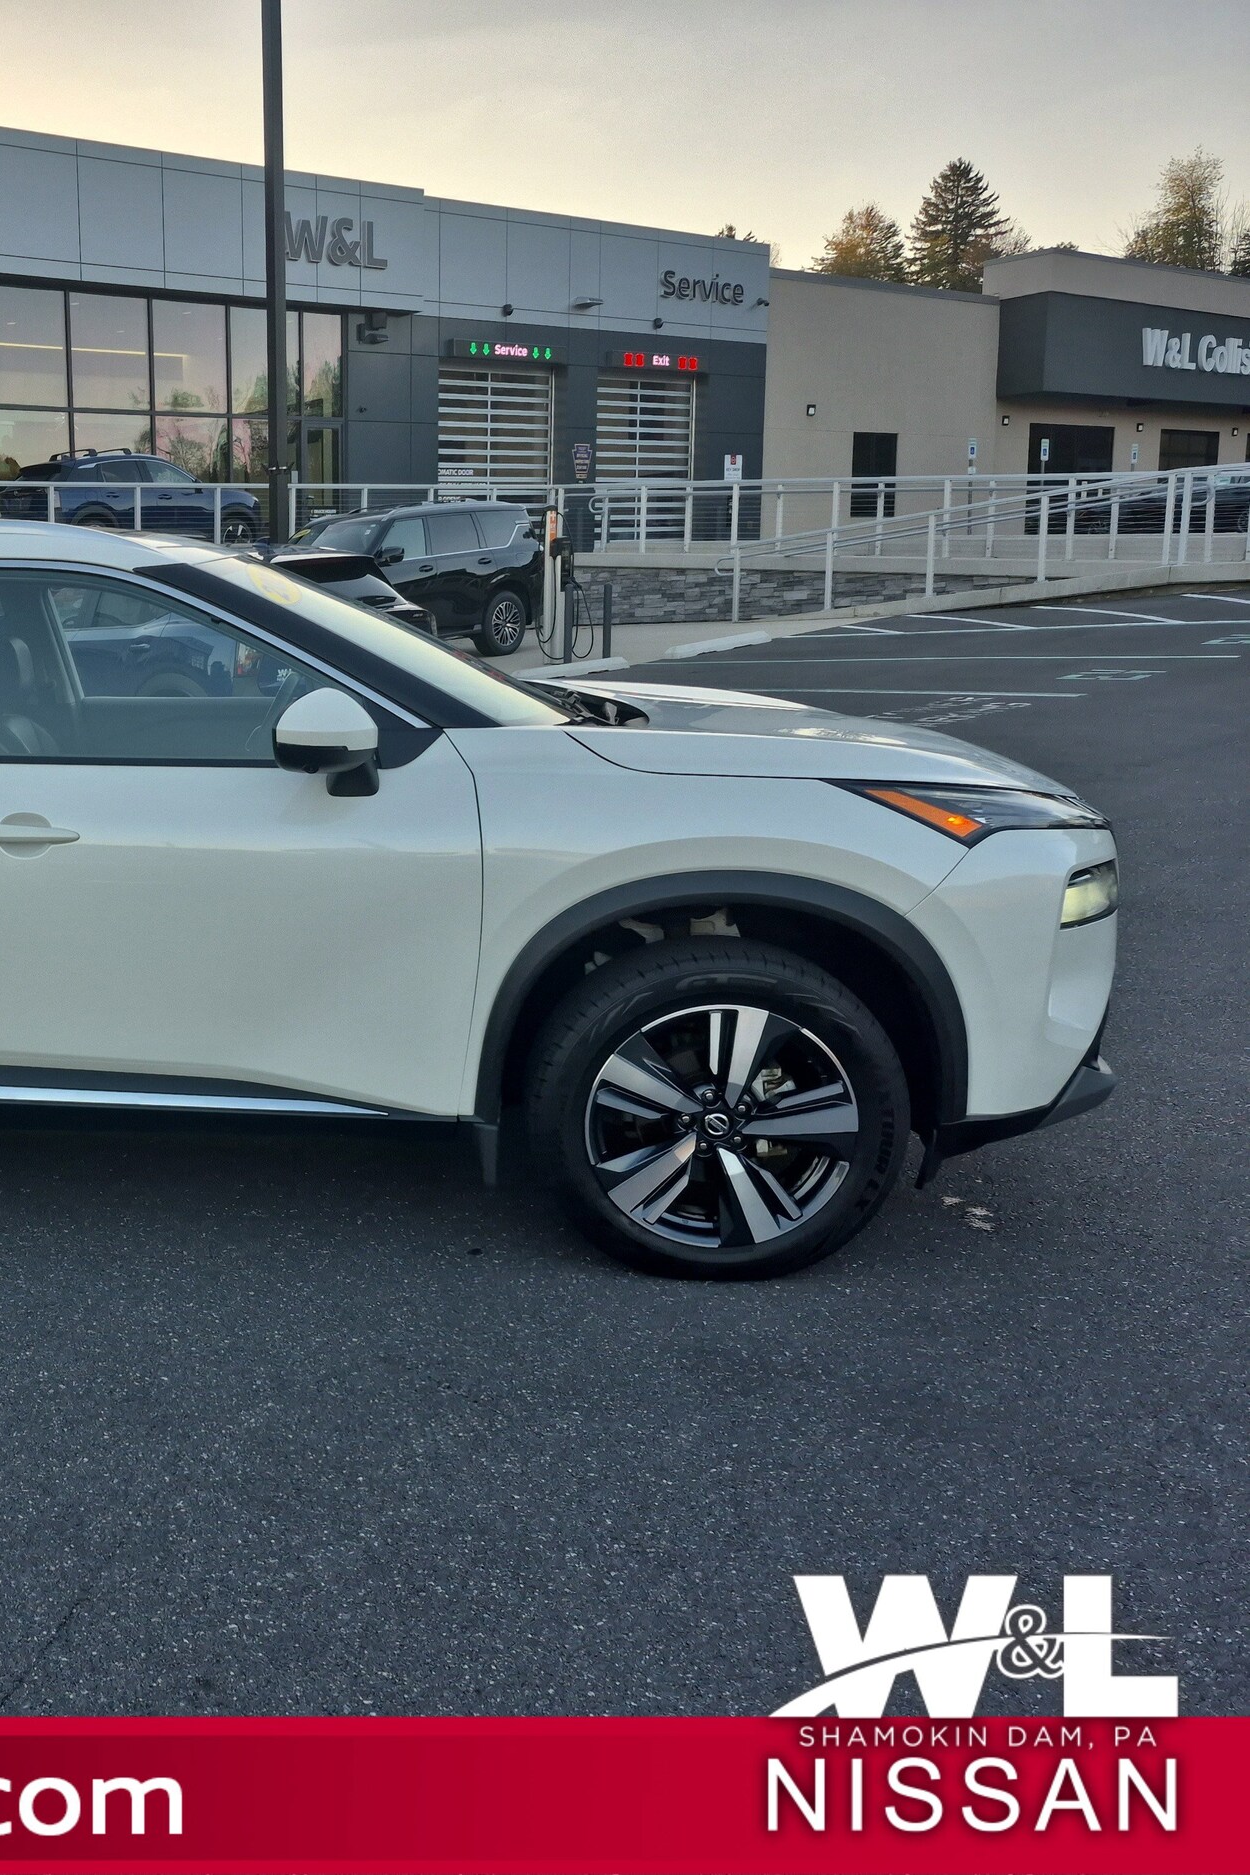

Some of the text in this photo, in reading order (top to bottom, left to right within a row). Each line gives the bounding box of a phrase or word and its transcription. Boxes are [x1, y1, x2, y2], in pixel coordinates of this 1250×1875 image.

[284, 211, 388, 270] W&L
[661, 270, 744, 305] Service
[494, 344, 528, 357] Service
[652, 355, 670, 366] Exit
[1142, 327, 1196, 370] W&L
